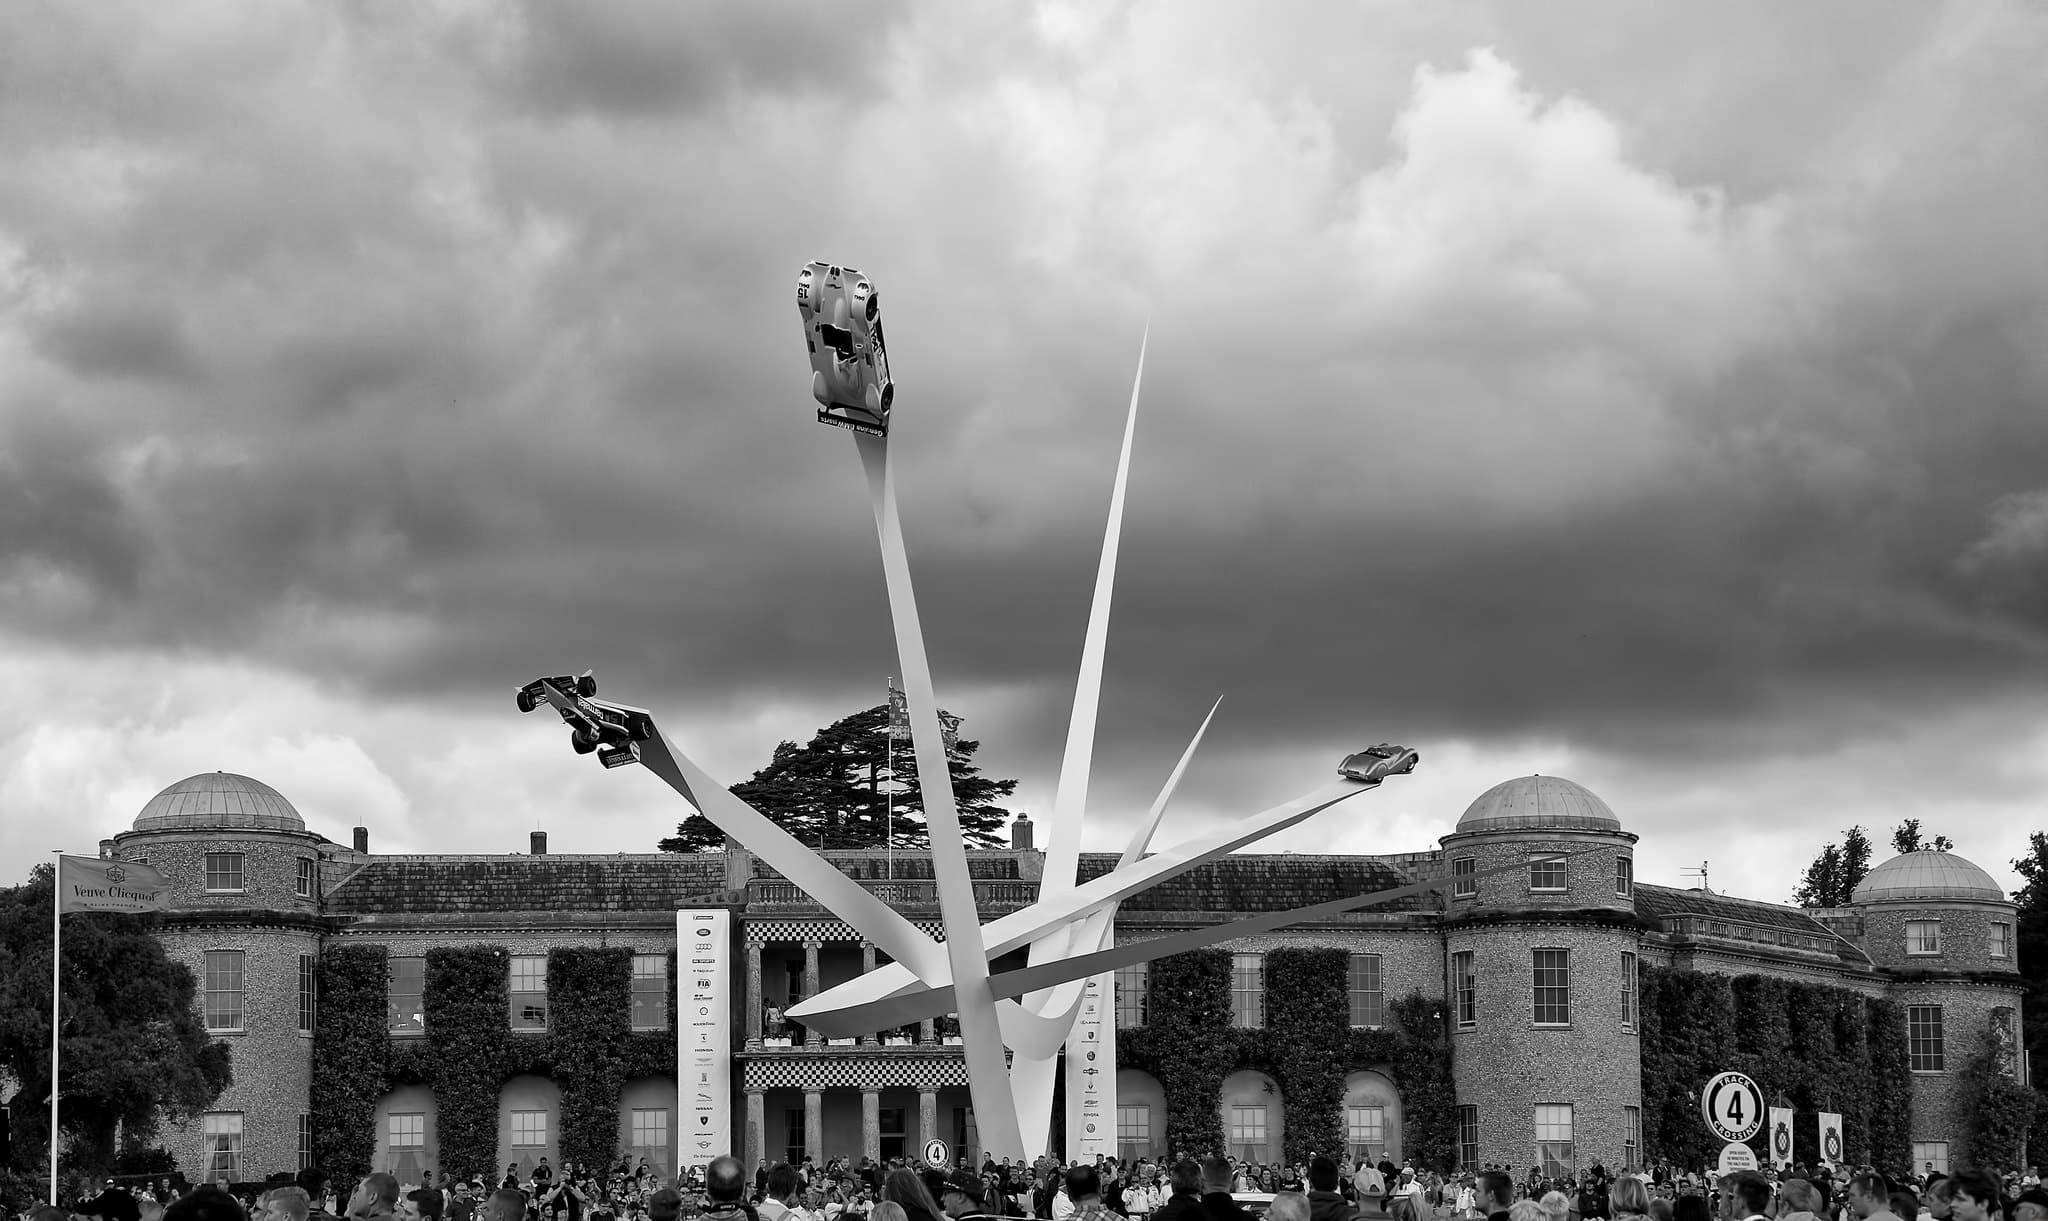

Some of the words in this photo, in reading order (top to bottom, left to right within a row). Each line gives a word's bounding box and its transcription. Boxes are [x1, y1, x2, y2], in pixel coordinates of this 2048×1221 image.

[798, 288, 808, 299] 15
[75, 885, 105, 897] Veuve
[109, 886, 160, 901] Clicquot
[697, 980, 710, 988] FIA
[1720, 1076, 1750, 1088] TRACK
[1727, 1090, 1744, 1125] 4
[1714, 1120, 1758, 1139] CROSSING
[933, 1146, 940, 1160] 4
